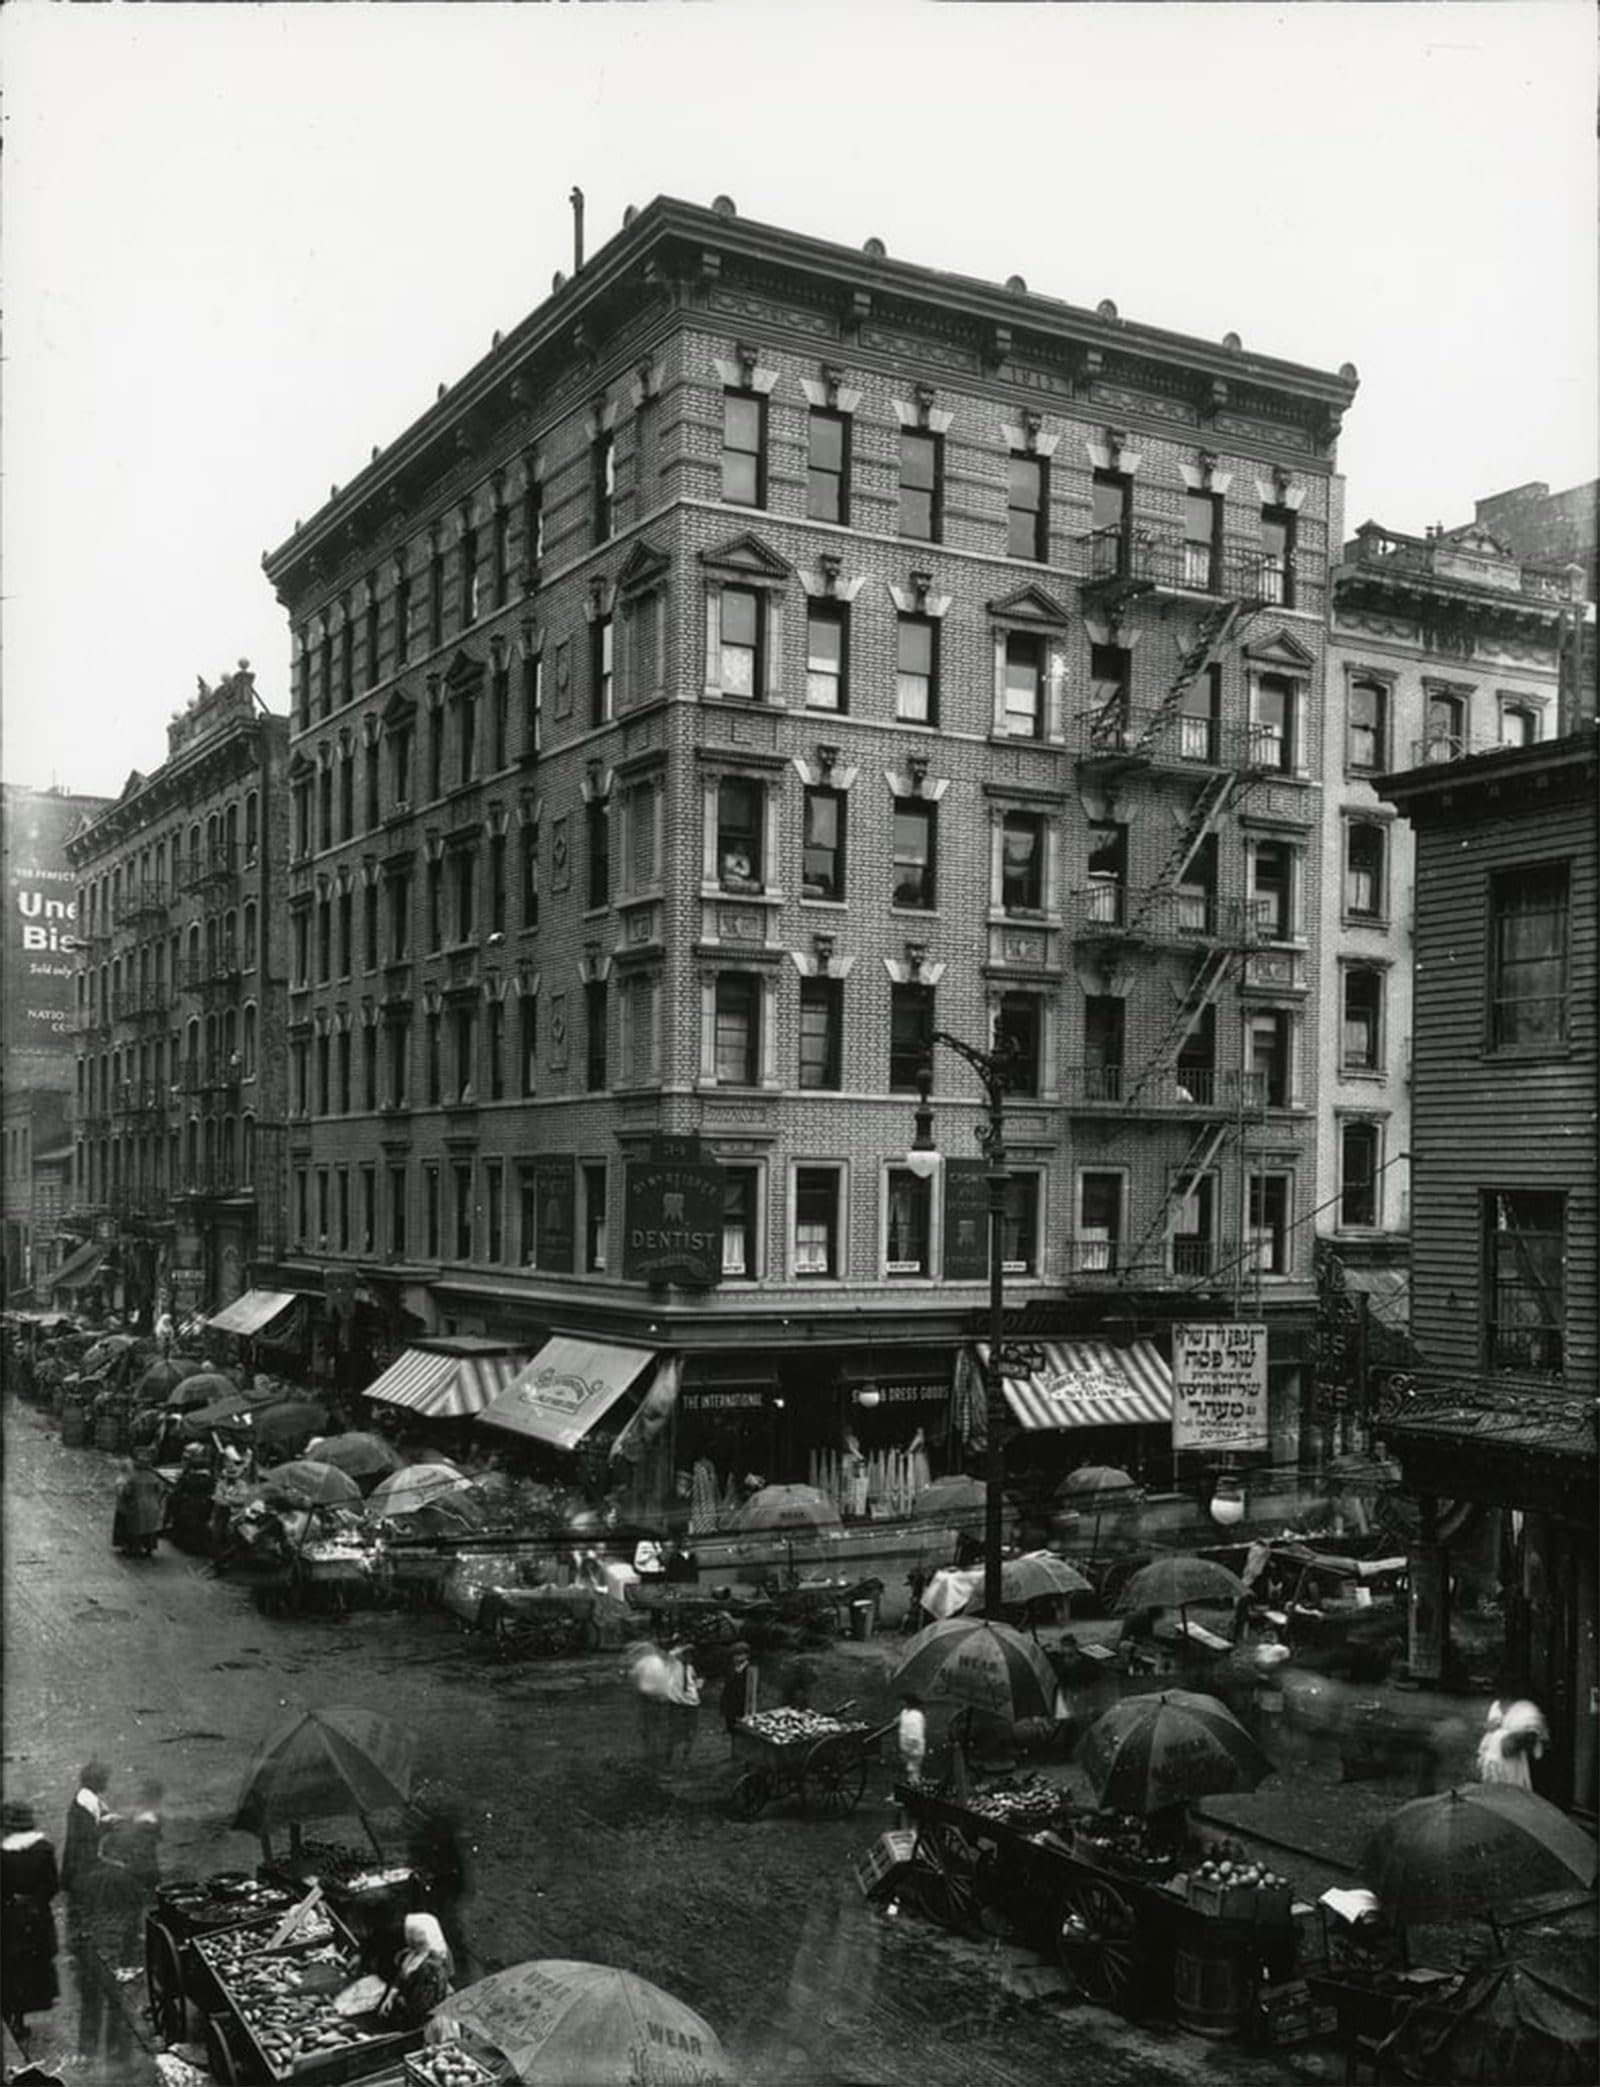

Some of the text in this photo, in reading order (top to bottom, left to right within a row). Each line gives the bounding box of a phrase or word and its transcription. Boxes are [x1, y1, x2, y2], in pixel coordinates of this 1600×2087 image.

[18, 891, 78, 920] Une
[23, 925, 77, 954] Bis
[631, 1229, 717, 1251] DENTIST
[888, 1386, 918, 1402] DRESS
[646, 2020, 703, 2057] WEAR
